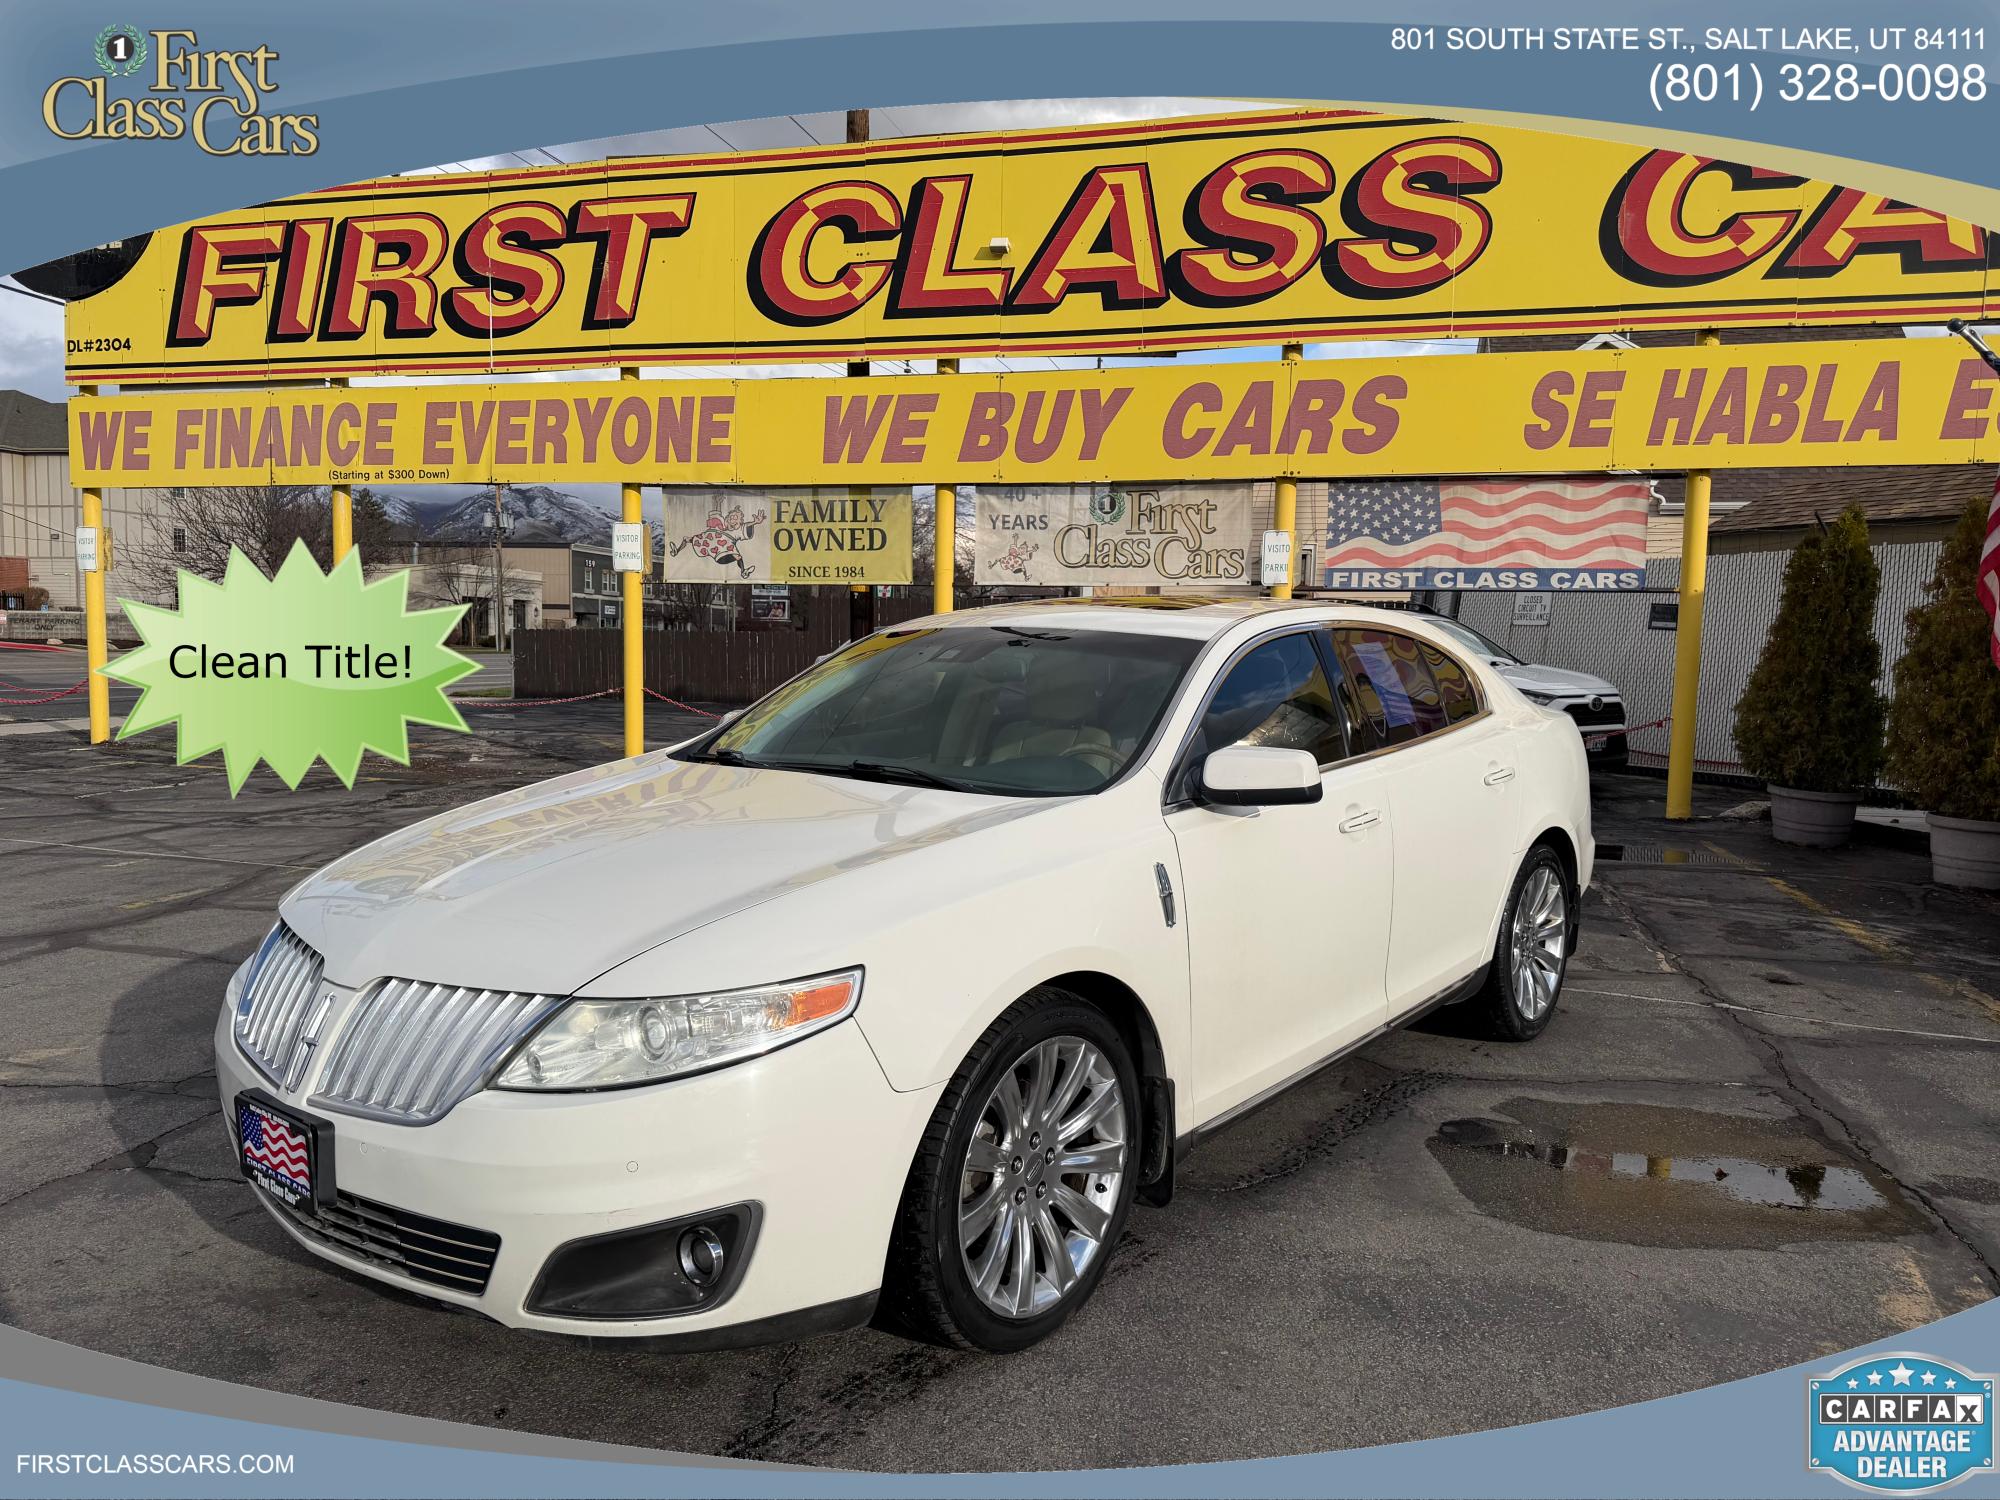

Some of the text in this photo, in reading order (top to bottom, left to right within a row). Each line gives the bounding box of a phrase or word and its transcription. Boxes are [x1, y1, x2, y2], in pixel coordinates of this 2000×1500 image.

[165, 192, 698, 348] FIRST
[747, 136, 1503, 327] CLASS
[67, 337, 132, 353] DL#2304
[79, 358, 2000, 470] WE FINANCE EVERYONE WE BUY CARS SE HABLA E
[328, 468, 450, 481] (Starting at $300 Down)
[773, 499, 887, 523] FAMILY
[988, 514, 1049, 530] YEARS
[1126, 490, 1217, 551] First
[616, 534, 639, 543] VISITOR
[773, 527, 887, 552] OWNED
[614, 551, 641, 560] PARKING
[1053, 523, 1245, 579] Class Cars
[788, 566, 865, 579] SINCE 1984
[1332, 572, 1639, 589] FIRST CLASS CARS
